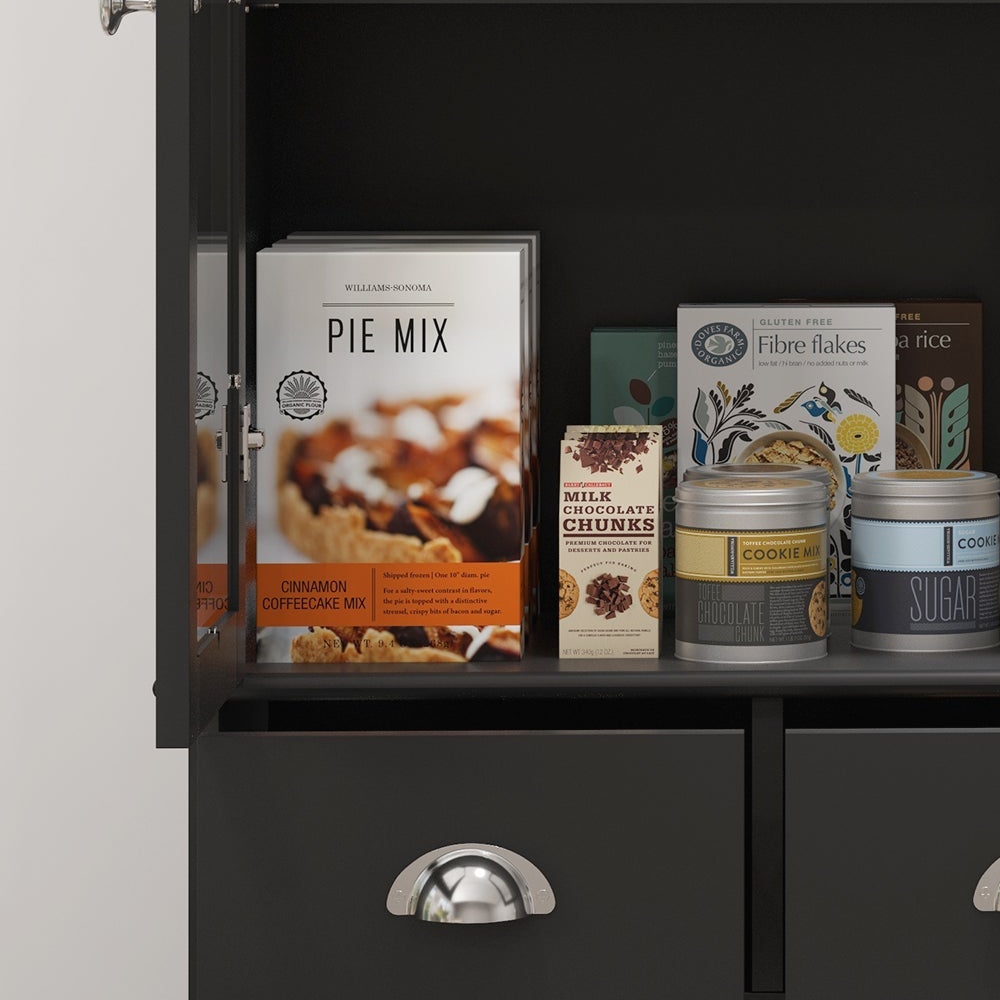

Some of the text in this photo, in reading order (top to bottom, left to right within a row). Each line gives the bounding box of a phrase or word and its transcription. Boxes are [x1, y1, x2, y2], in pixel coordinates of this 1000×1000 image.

[328, 318, 448, 353] PIE MIX
[695, 325, 744, 347] DOVES FARM
[916, 330, 951, 348] rice
[759, 334, 867, 354] Fibre flakes
[698, 349, 742, 365] ORGANIC
[563, 491, 612, 502] MILK
[563, 505, 655, 514] CHOCOLATE
[563, 518, 655, 531] CHUNKS
[958, 534, 997, 549] COOKIE
[743, 545, 821, 560] COOKIE MIX
[281, 580, 347, 593] CINNAMON
[262, 597, 366, 610] COFFEECAKE MIX
[910, 575, 976, 622] SUGAR
[698, 600, 765, 625] CHOCOLATE
[735, 625, 765, 642] CHUNK
